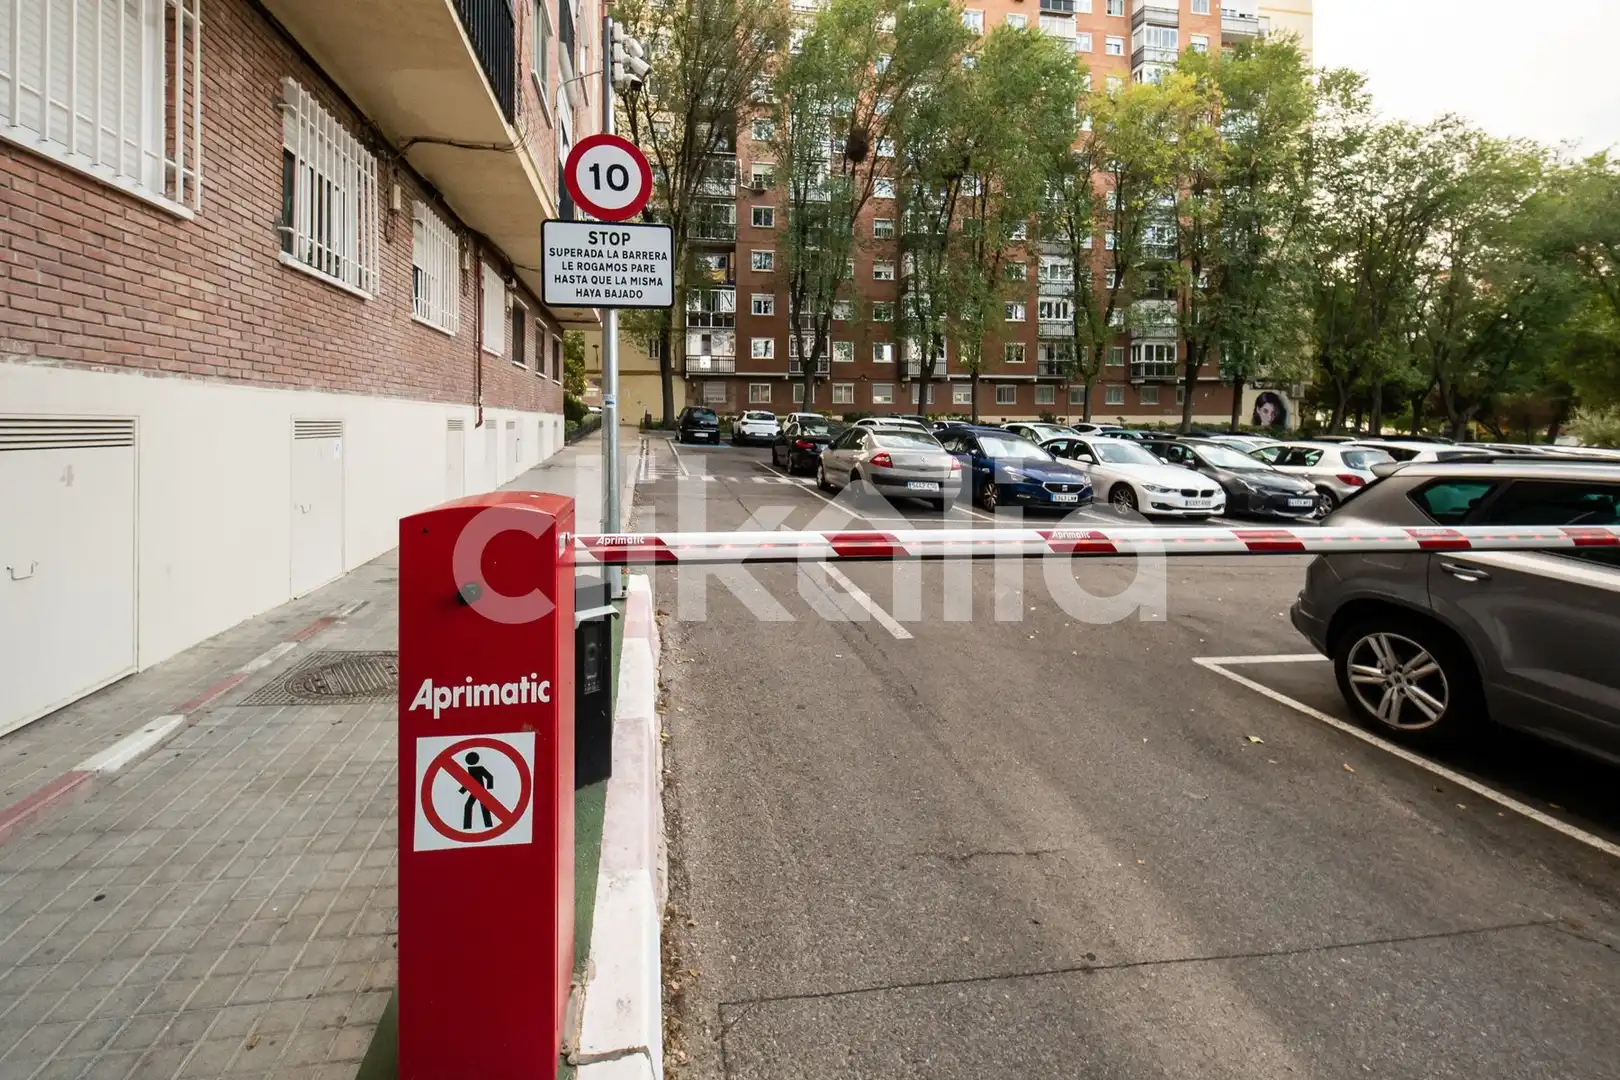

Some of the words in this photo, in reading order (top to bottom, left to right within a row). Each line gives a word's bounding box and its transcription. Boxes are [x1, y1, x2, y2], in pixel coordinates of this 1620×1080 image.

[589, 163, 629, 191] 10
[588, 231, 631, 246] STOP
[549, 247, 604, 259] SUPERADA
[607, 250, 619, 259] LA
[623, 250, 668, 261] BARRERA
[562, 261, 574, 271] LE
[577, 262, 628, 272] ROGAMOS
[631, 264, 656, 273] PARE
[554, 274, 588, 284] HASTA
[590, 275, 612, 285] QUE
[615, 276, 627, 285] LA
[630, 277, 663, 287] MISMA
[576, 288, 602, 298] HAYA
[605, 289, 643, 299] BAJADO
[596, 535, 645, 546] Aprimatic
[408, 672, 551, 719] Aprimatic
